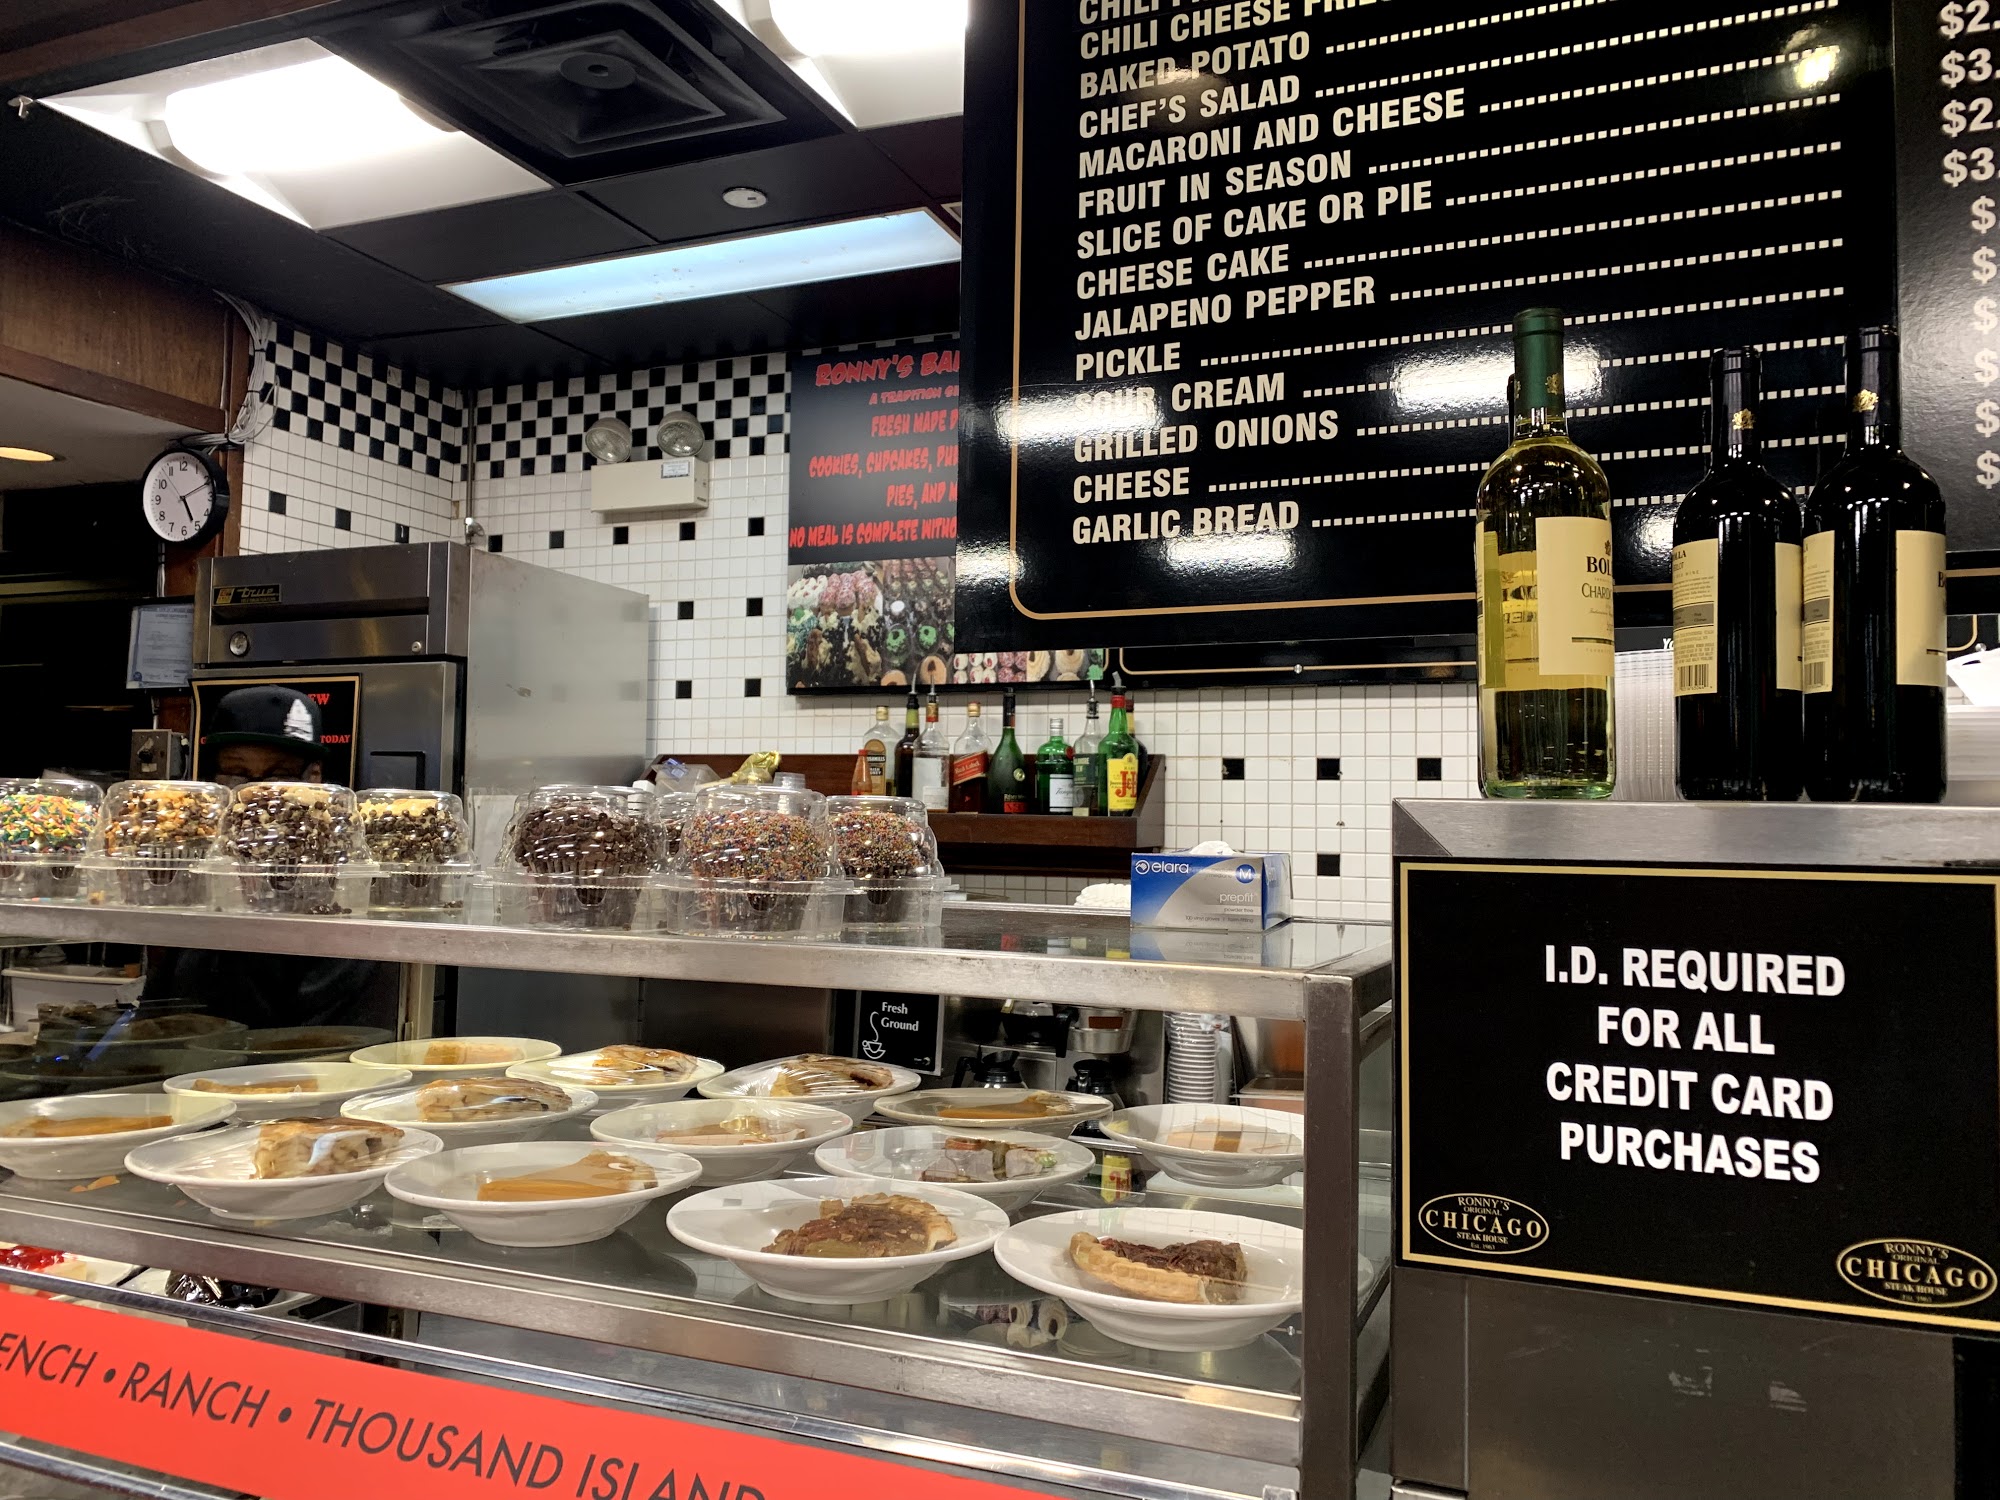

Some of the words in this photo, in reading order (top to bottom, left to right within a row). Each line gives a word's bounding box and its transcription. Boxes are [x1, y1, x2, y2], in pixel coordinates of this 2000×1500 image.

[1081, 20, 1157, 58] CHILI
[1171, 0, 1290, 41] CHEESE
[1081, 56, 1175, 99] BAKED
[1191, 31, 1309, 79] POTATO
[1080, 95, 1186, 138] CHEF'S
[1200, 76, 1299, 117] SALAD
[1080, 126, 1240, 178] MACARONI
[1254, 114, 1318, 150] AND
[1333, 88, 1464, 136] CHEESE
[1079, 179, 1165, 218] FRUIT
[1180, 172, 1209, 202] IN
[1226, 150, 1350, 195] SEASON
[1078, 220, 1160, 258] SLICE
[1173, 213, 1211, 245] OF
[1224, 199, 1305, 237] CAKE
[1320, 192, 1364, 223] OR
[1378, 181, 1431, 215] PIE
[1077, 256, 1192, 299] CHEESE
[1208, 244, 1288, 281] CAKE
[1075, 294, 1231, 340] JALAPENO
[1247, 276, 1375, 319] PEPPER
[815, 354, 914, 387] RONNY'S
[1076, 342, 1180, 381] PICKLE
[869, 392, 878, 405] A
[881, 387, 942, 404] TRADITION
[1074, 386, 1156, 422] SOUR
[1172, 373, 1284, 412] CREAM
[871, 414, 910, 437] FRESH
[913, 410, 947, 433] MADE
[1074, 425, 1198, 463] GRILLED
[1215, 410, 1338, 450] ONIONS
[179, 460, 188, 472] 12
[809, 453, 862, 479] COOKIES,
[866, 447, 932, 474] CUPCAKES,
[158, 479, 167, 489] 10
[886, 484, 917, 510] PIES,
[921, 482, 946, 504] AND
[1074, 467, 1189, 503] CHEESE
[155, 495, 161, 505] 9
[159, 511, 165, 521] 8
[168, 522, 174, 532] 7
[194, 520, 200, 531] 5
[1073, 510, 1179, 544] GARLIC
[1193, 501, 1299, 537] BREAD
[181, 526, 187, 536] 6
[789, 527, 805, 548] NO
[808, 524, 838, 547] MEAL
[841, 523, 854, 545] IS
[856, 519, 918, 544] COMPLETE
[320, 735, 350, 744] TODAY
[1151, 861, 1189, 874] elara
[1239, 868, 1251, 879] M
[1219, 893, 1253, 903] prepfit
[1546, 945, 1607, 984] I.D.
[1623, 948, 1844, 996] REQUIRED
[882, 1002, 908, 1014] Fresh
[881, 1017, 919, 1031] Ground
[1599, 1006, 1681, 1048] FOR
[1693, 1012, 1774, 1054] ALL
[1547, 1062, 1697, 1110] CREDIT
[1712, 1074, 1833, 1120] CARD
[1561, 1122, 1819, 1183] PURCHASES
[1458, 1197, 1510, 1211] RONNY'S
[1463, 1206, 1502, 1216] ORIGINAL
[1425, 1209, 1541, 1238] CHICAGO
[1456, 1231, 1481, 1241] STEAK
[1482, 1234, 1508, 1244] HOUSE
[1884, 1243, 1949, 1259] RONNY'S
[1892, 1254, 1940, 1265] ORIGINAL
[1845, 1257, 1988, 1290] CHICAGO
[1884, 1282, 1915, 1293] STEAK
[1916, 1285, 1948, 1296] HOUSE
[119, 1361, 270, 1428] RANCH
[306, 1399, 563, 1489] THOUSAND
